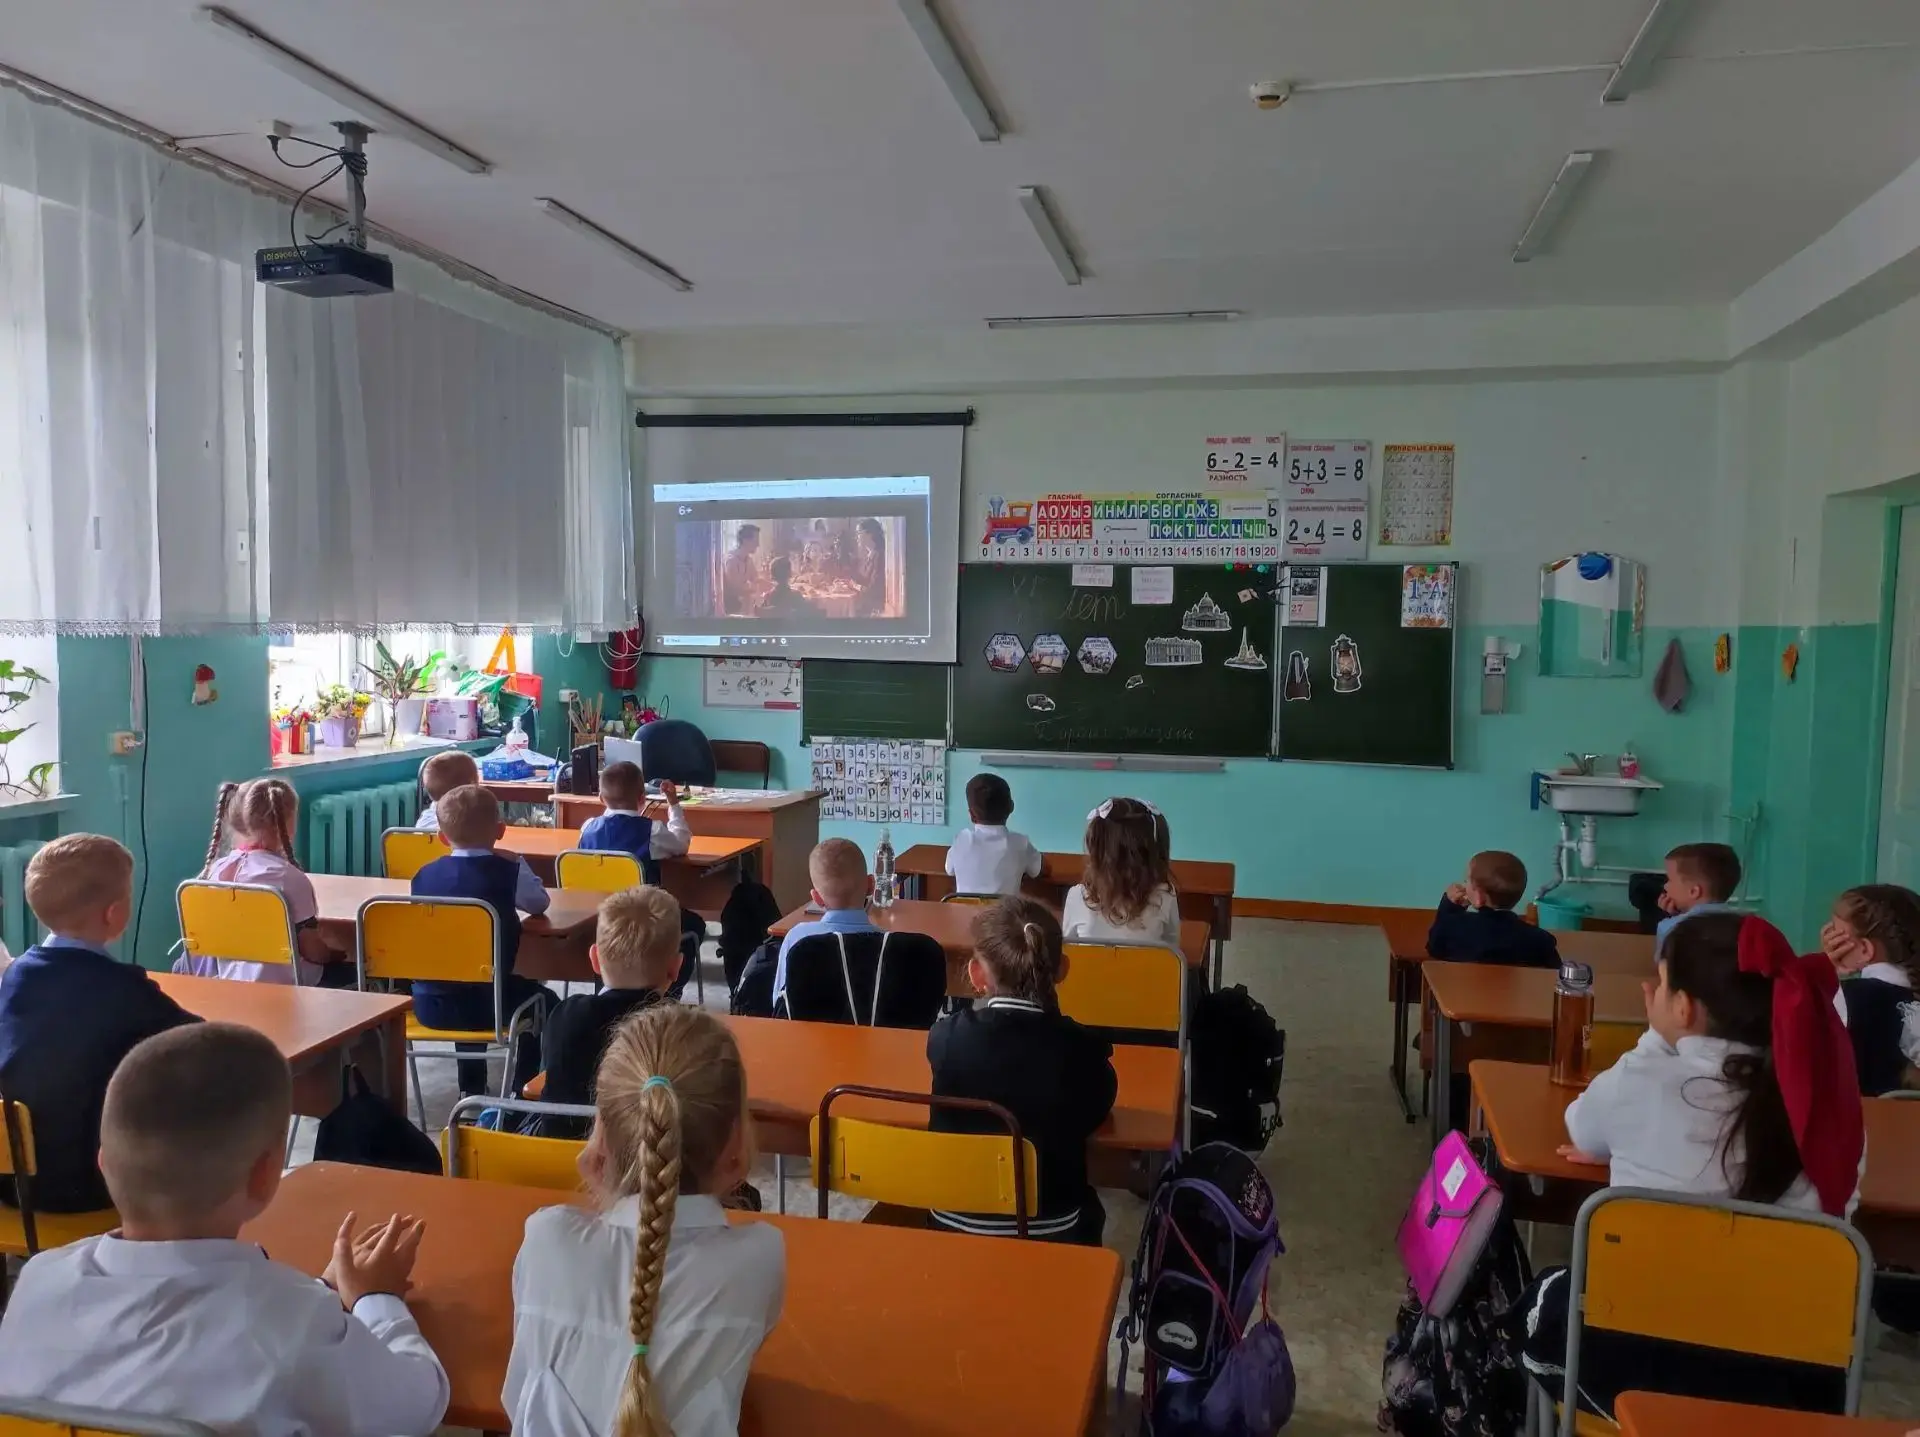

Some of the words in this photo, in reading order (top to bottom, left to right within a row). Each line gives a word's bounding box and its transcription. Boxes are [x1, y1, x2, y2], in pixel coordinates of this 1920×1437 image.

[1207, 452, 1217, 468] 6
[1234, 452, 1244, 468] 2
[1268, 452, 1278, 468] 4
[1354, 458, 1364, 481] 8
[1209, 474, 1248, 482] РАЗНОСТЬ
[678, 505, 692, 516] 6+
[1288, 519, 1298, 541] 2
[1315, 519, 1325, 541] 4
[1352, 518, 1362, 541] 8
[982, 547, 988, 556] 0
[996, 547, 1001, 556] 1
[1010, 547, 1015, 556] 2
[1023, 547, 1029, 556] 3
[1037, 547, 1043, 556] 4
[1051, 547, 1057, 556] 5
[1065, 547, 1071, 556] 6
[1079, 547, 1085, 556] 7
[1093, 547, 1099, 556] 8
[1107, 547, 1113, 556] 9
[1119, 547, 1129, 556] 10
[1134, 547, 1144, 556] 11
[1162, 547, 1173, 556] 13
[1176, 547, 1187, 556] 14
[1191, 547, 1202, 556] 15
[1206, 547, 1216, 556] 16
[1220, 547, 1231, 556] 17
[1235, 547, 1246, 556] 18
[1250, 547, 1260, 556] 19
[1265, 547, 1276, 556] 20
[1291, 604, 1303, 612] 27
[836, 748, 841, 758] 2
[849, 749, 854, 757] 3
[858, 749, 864, 757] 4
[870, 750, 875, 758] 5
[880, 750, 886, 759] 6
[903, 750, 909, 760] 8
[915, 750, 921, 759] 9
